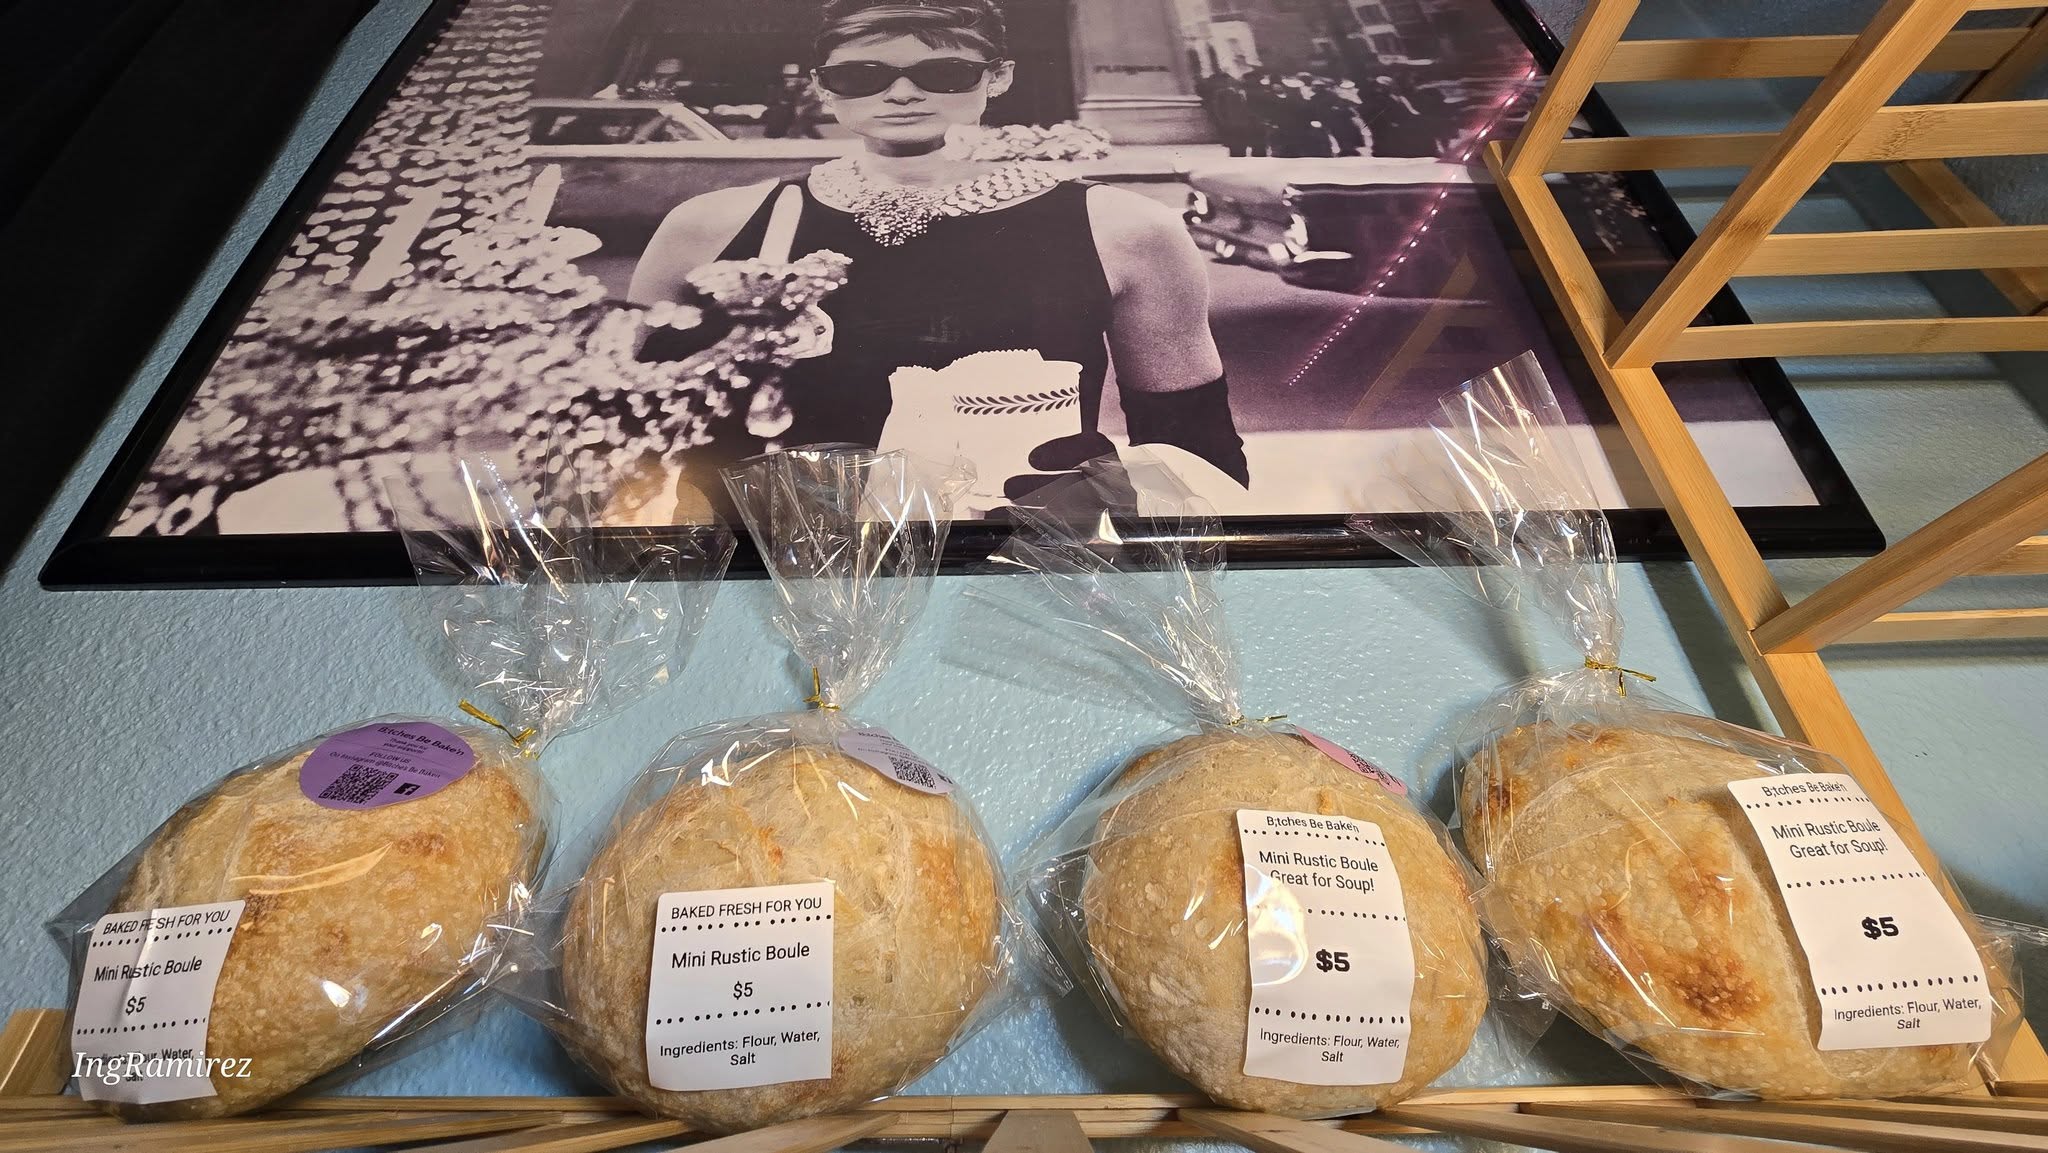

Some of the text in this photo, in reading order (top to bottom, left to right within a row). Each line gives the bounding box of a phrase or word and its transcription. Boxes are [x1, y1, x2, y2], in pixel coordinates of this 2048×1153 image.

[416, 735, 432, 744] Be
[369, 751, 400, 762] FOLLOW
[1806, 782, 1820, 793] Be
[1309, 818, 1324, 830] Be
[1771, 817, 1881, 839] Mini Rustic Boule
[1789, 838, 1888, 859] Great for Soup!
[1259, 851, 1379, 873] Mini Rustic Boule
[1270, 869, 1375, 894] Great for Soup!
[671, 897, 823, 920] BAKED FRESH FOR YOU
[102, 920, 139, 935] BAKED
[177, 913, 202, 928] FOR
[204, 909, 231, 924] YOU
[1861, 916, 1899, 940] $5
[671, 942, 811, 969] Mini Rustic Boule
[1315, 948, 1351, 973] $5
[94, 956, 203, 982] Mini Rustic Boule
[732, 981, 754, 1000] $5
[125, 996, 147, 1015] $5
[1833, 997, 1982, 1022] Ingredients: Flour, Water,
[1896, 1017, 1921, 1030] Salt
[660, 1030, 820, 1059] Ingredients: Flour, Water,
[1260, 1028, 1400, 1049] Ingredients: Flour, Water,
[730, 1052, 756, 1066] Salt
[1321, 1051, 1344, 1063] Salt
